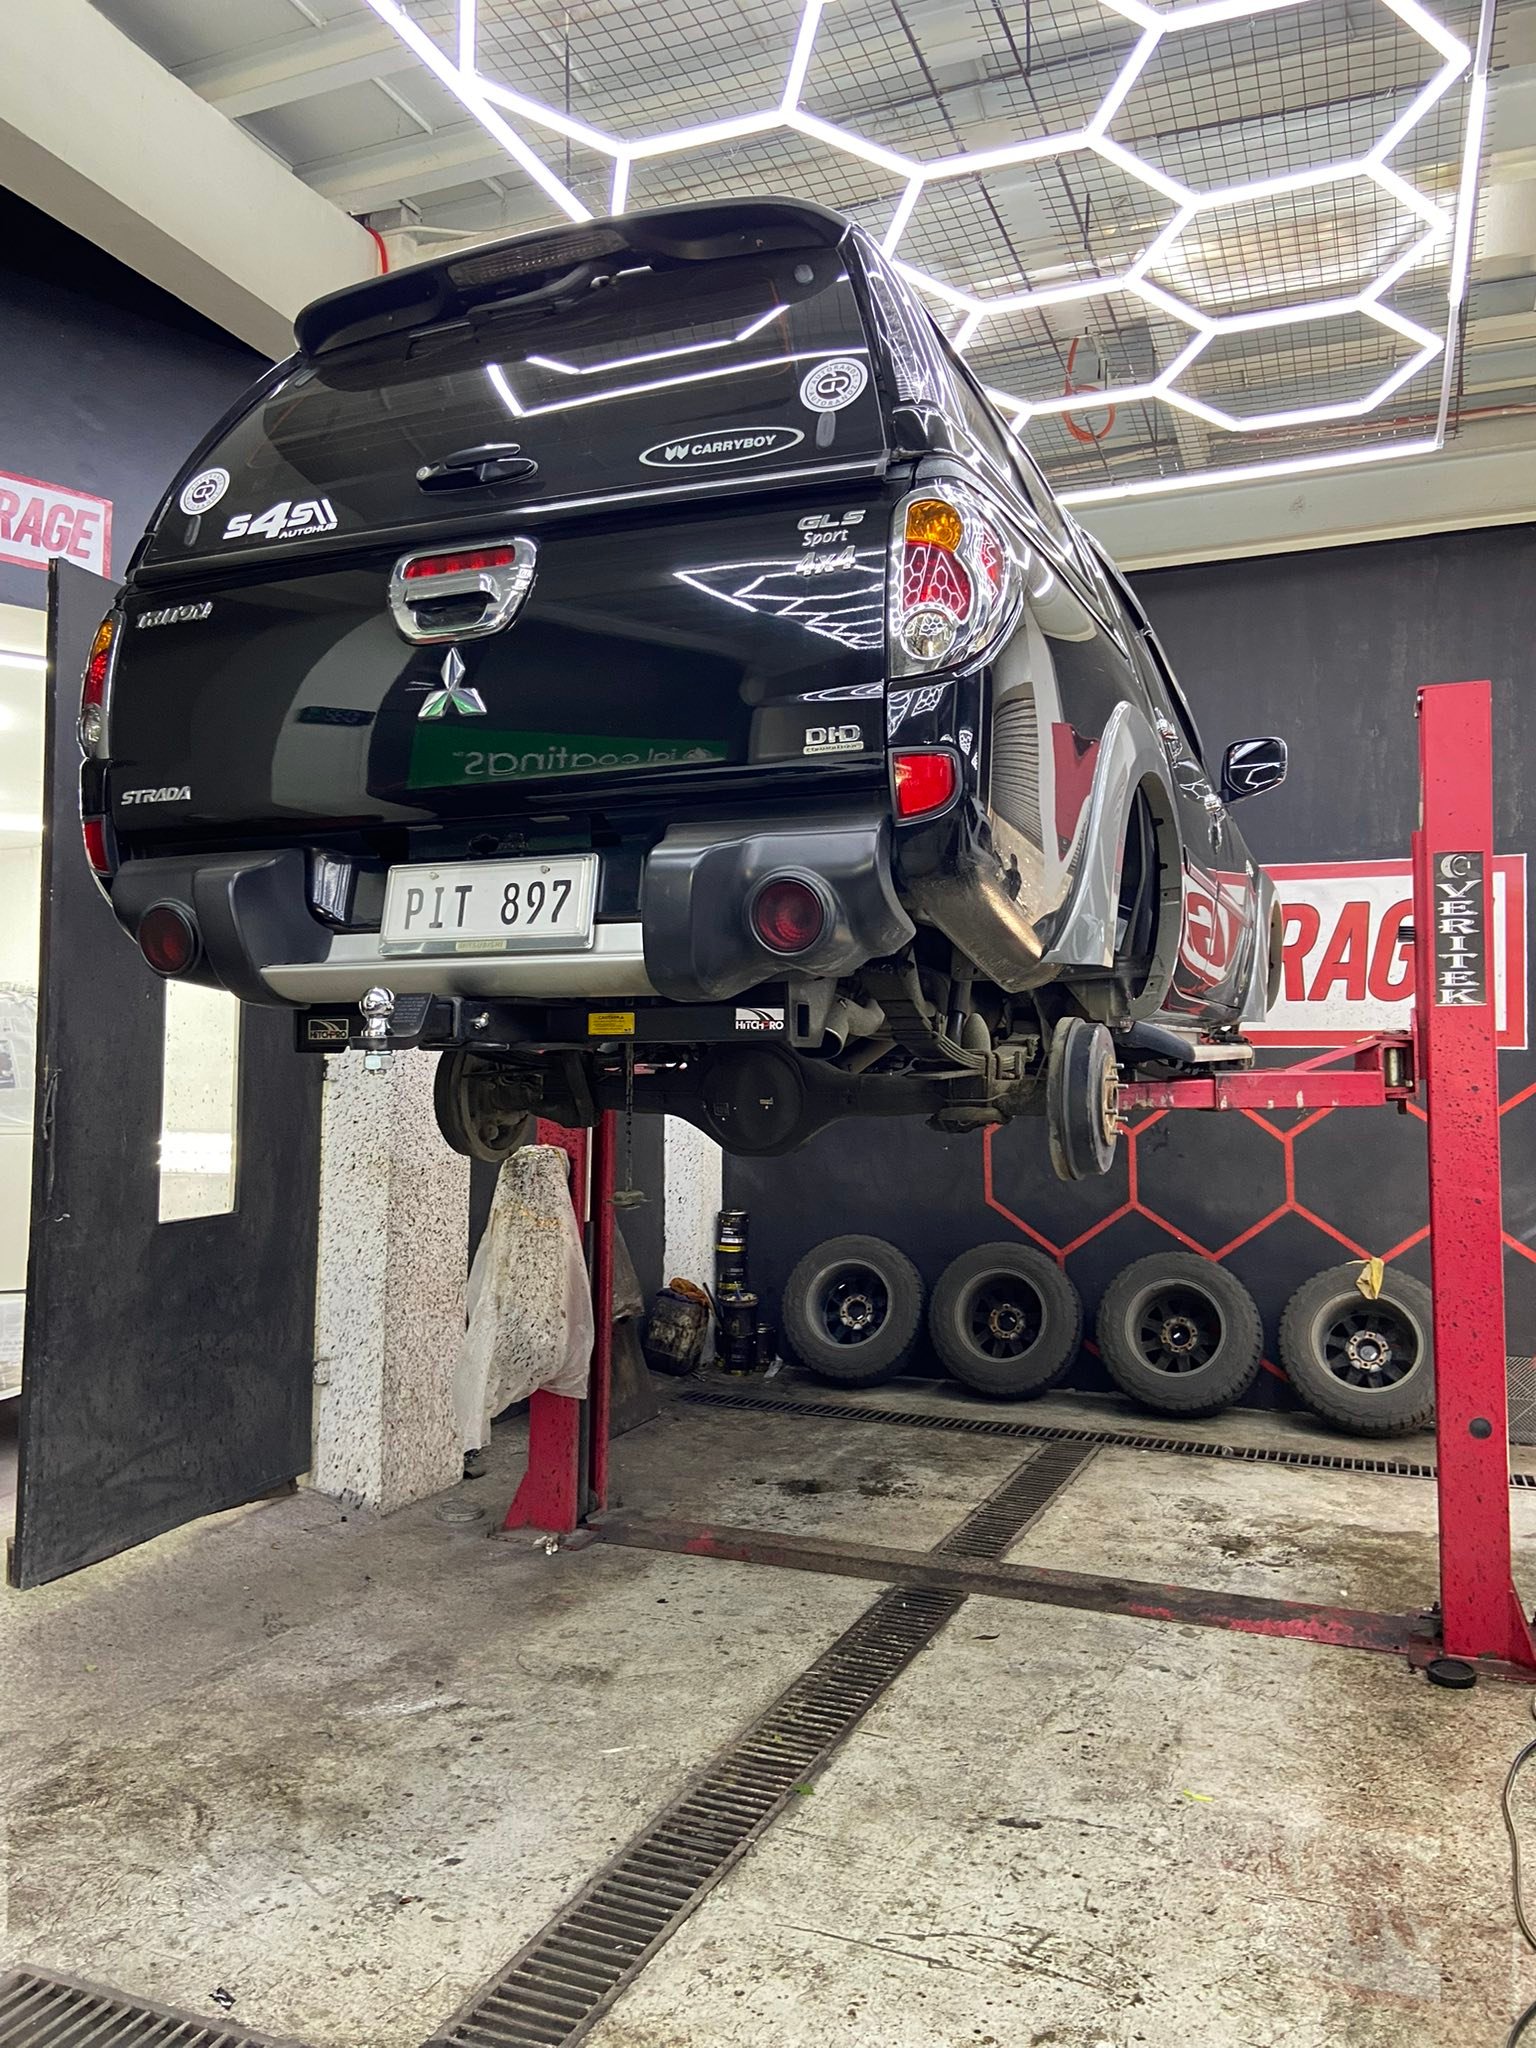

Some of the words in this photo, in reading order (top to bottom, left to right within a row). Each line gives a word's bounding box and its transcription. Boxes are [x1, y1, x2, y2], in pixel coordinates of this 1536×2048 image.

[691, 434, 777, 456] CARRYBOY
[279, 521, 338, 539] AUTOHUB
[797, 509, 867, 531] GLS
[801, 529, 849, 548] Sport
[796, 544, 856, 577] 4x4
[121, 783, 191, 806] STRADA
[404, 885, 473, 930] PIT
[500, 879, 572, 925] 897
